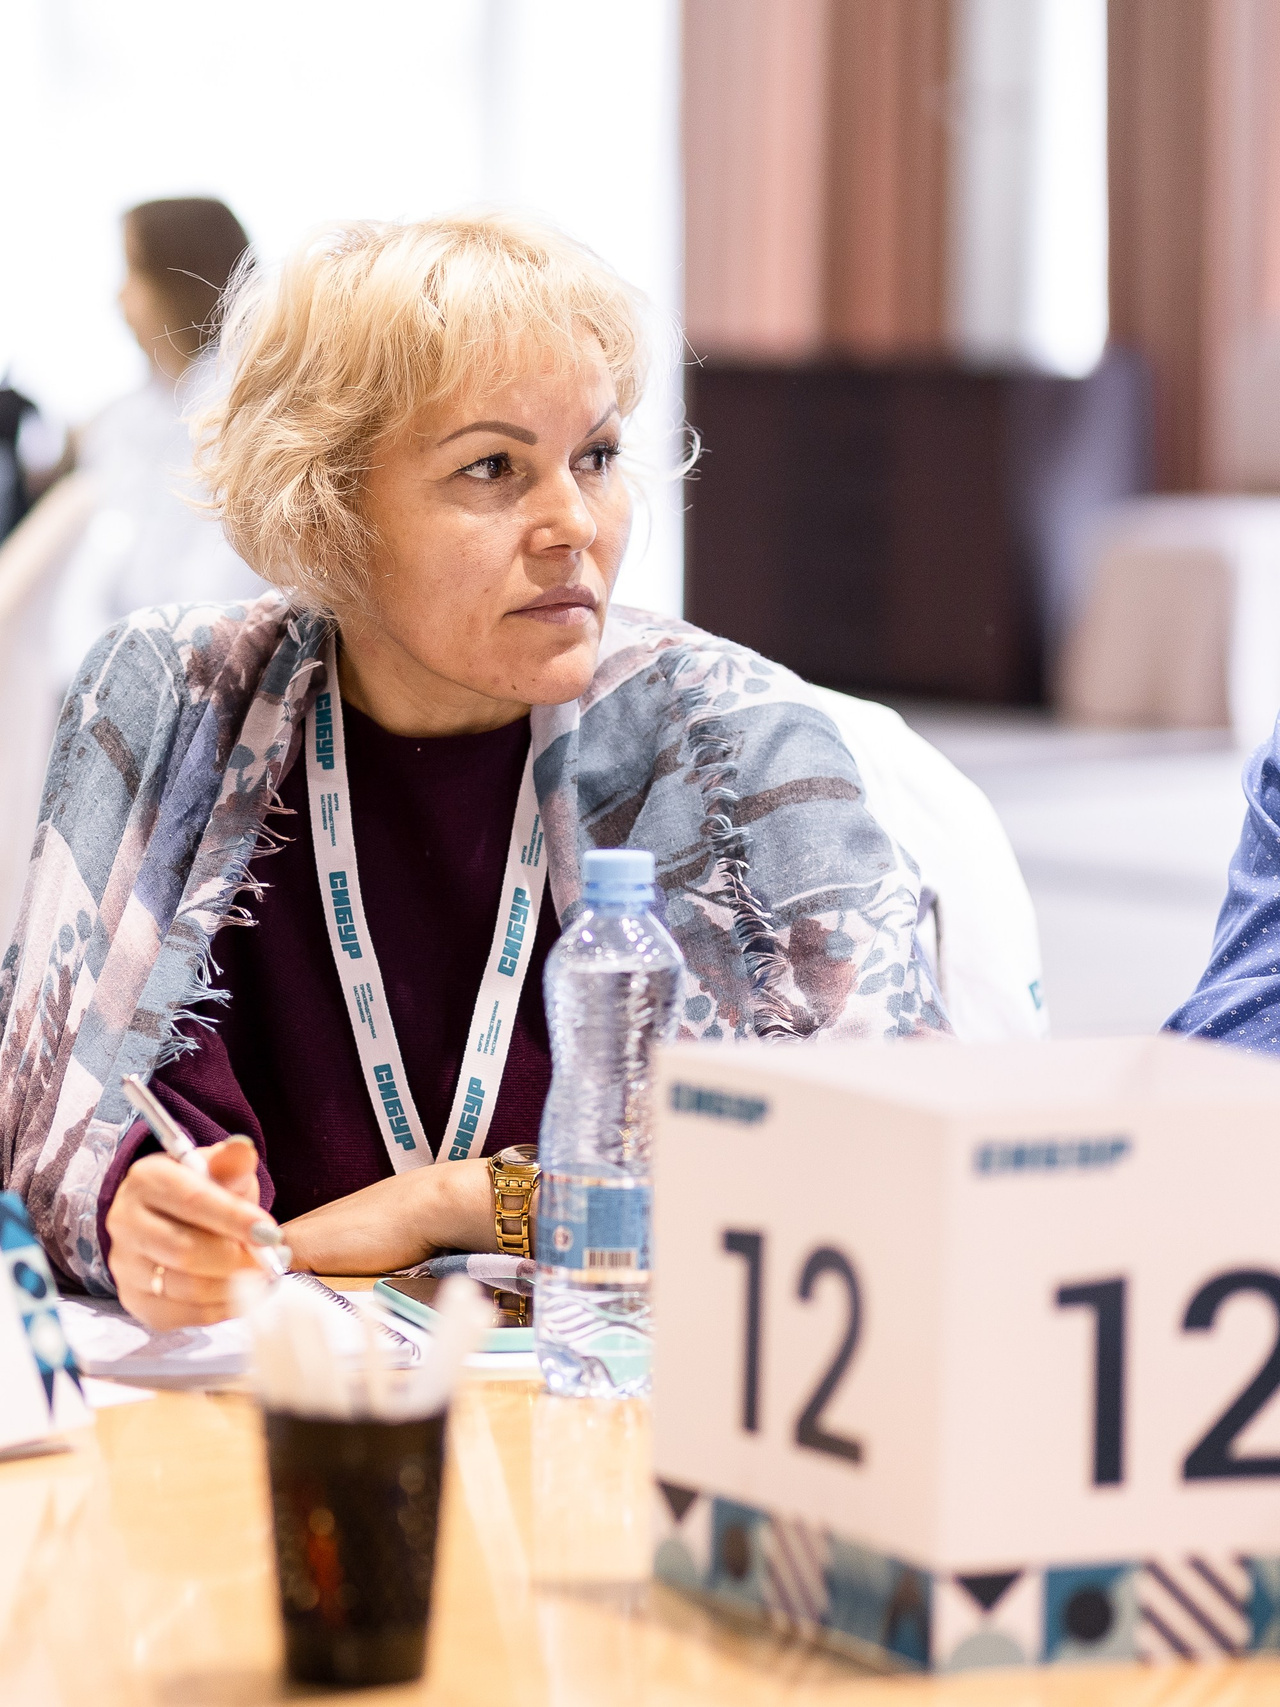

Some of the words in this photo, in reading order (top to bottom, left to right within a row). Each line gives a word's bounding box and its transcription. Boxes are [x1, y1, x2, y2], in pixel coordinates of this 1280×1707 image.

[316, 692, 334, 770] СИБУР
[329, 871, 363, 960] СИБУР
[497, 886, 531, 977] СИБУР
[373, 1063, 417, 1151] СИБУР
[448, 1076, 486, 1161] СИБУР
[719, 1227, 868, 1465] 12
[1053, 1267, 1280, 1491] 12
